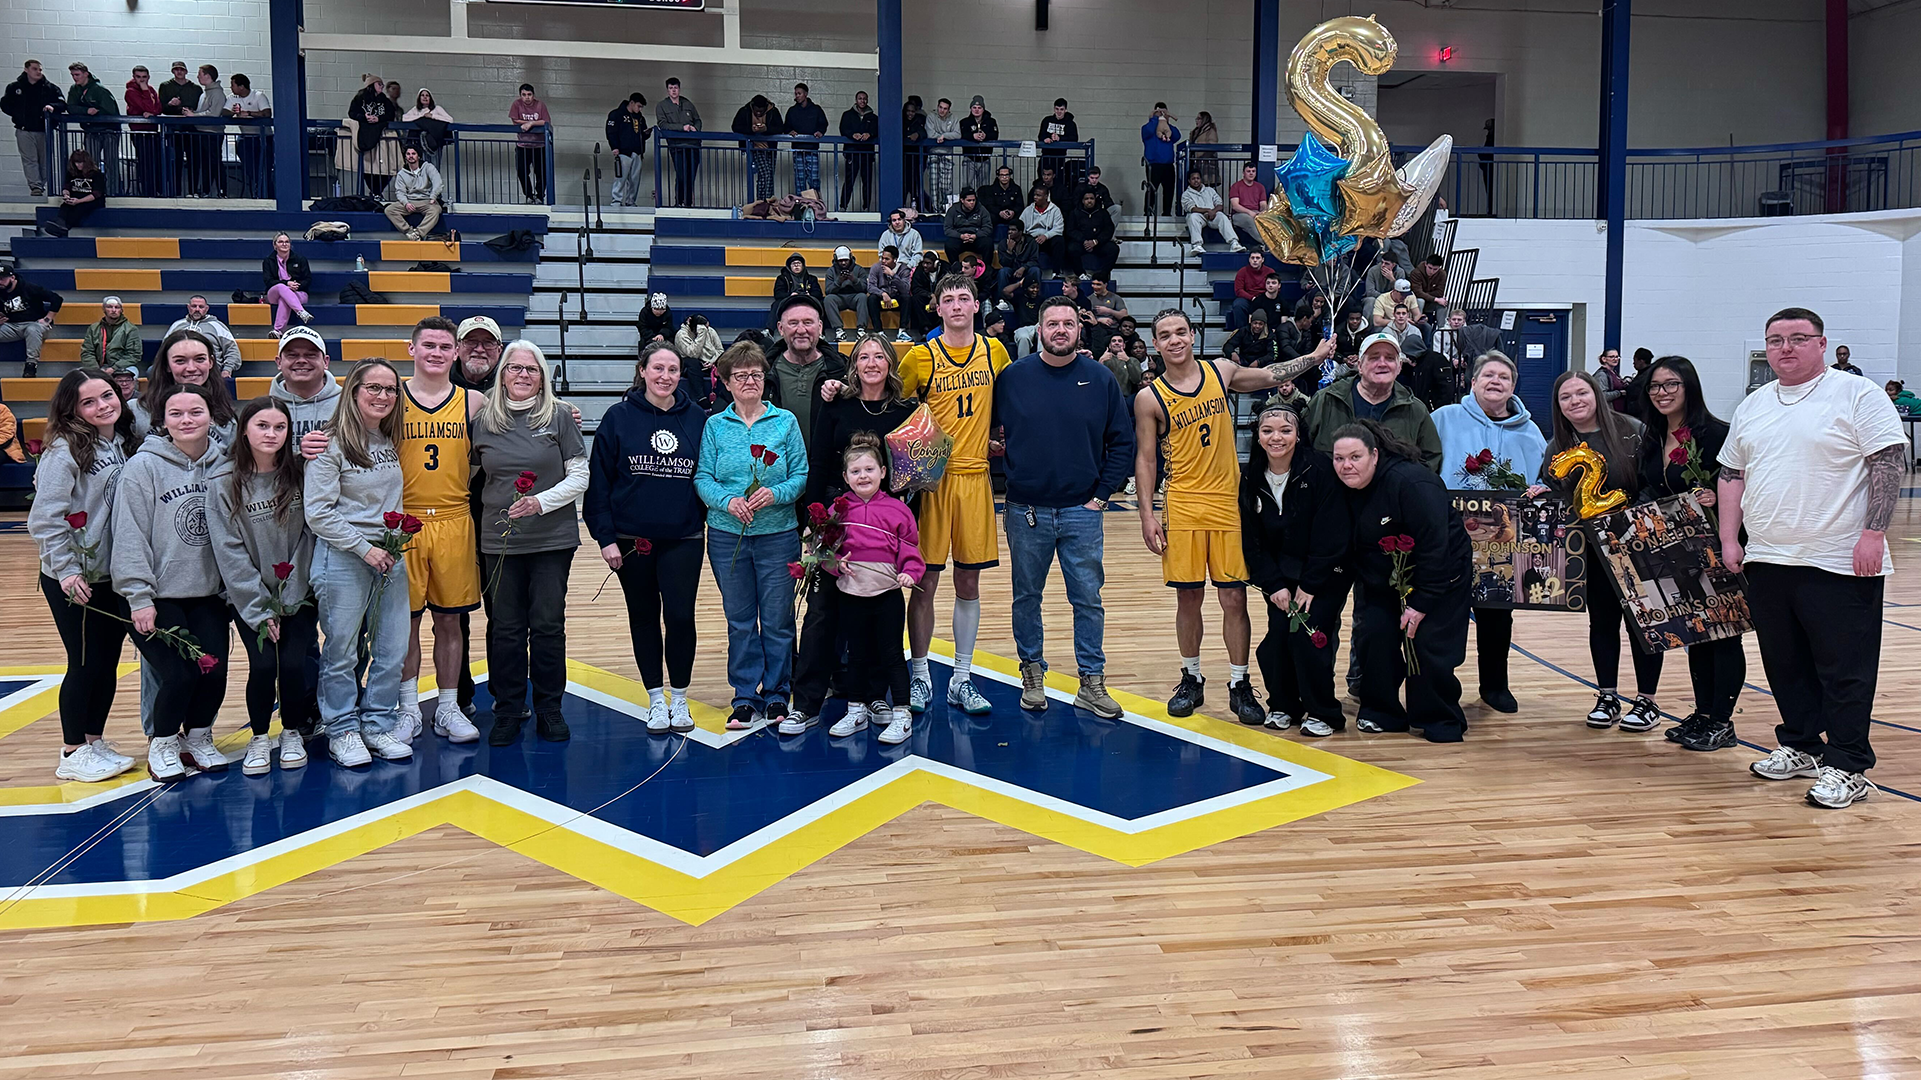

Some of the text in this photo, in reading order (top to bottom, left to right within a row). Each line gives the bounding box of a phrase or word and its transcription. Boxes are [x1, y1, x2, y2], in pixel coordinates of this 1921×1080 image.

[935, 370, 991, 393] WILLIAMSON
[956, 392, 974, 418] 11
[1172, 397, 1226, 430] WILLIAMSON
[658, 437, 672, 448] W
[1198, 422, 1211, 448] 2
[424, 444, 439, 471] 3
[1548, 441, 1629, 519] 2
[1482, 541, 1553, 554] JOHNSON
[1619, 525, 1696, 557] RONALD
[1529, 577, 1566, 604] #2
[1643, 591, 1735, 625] JOHNSON
